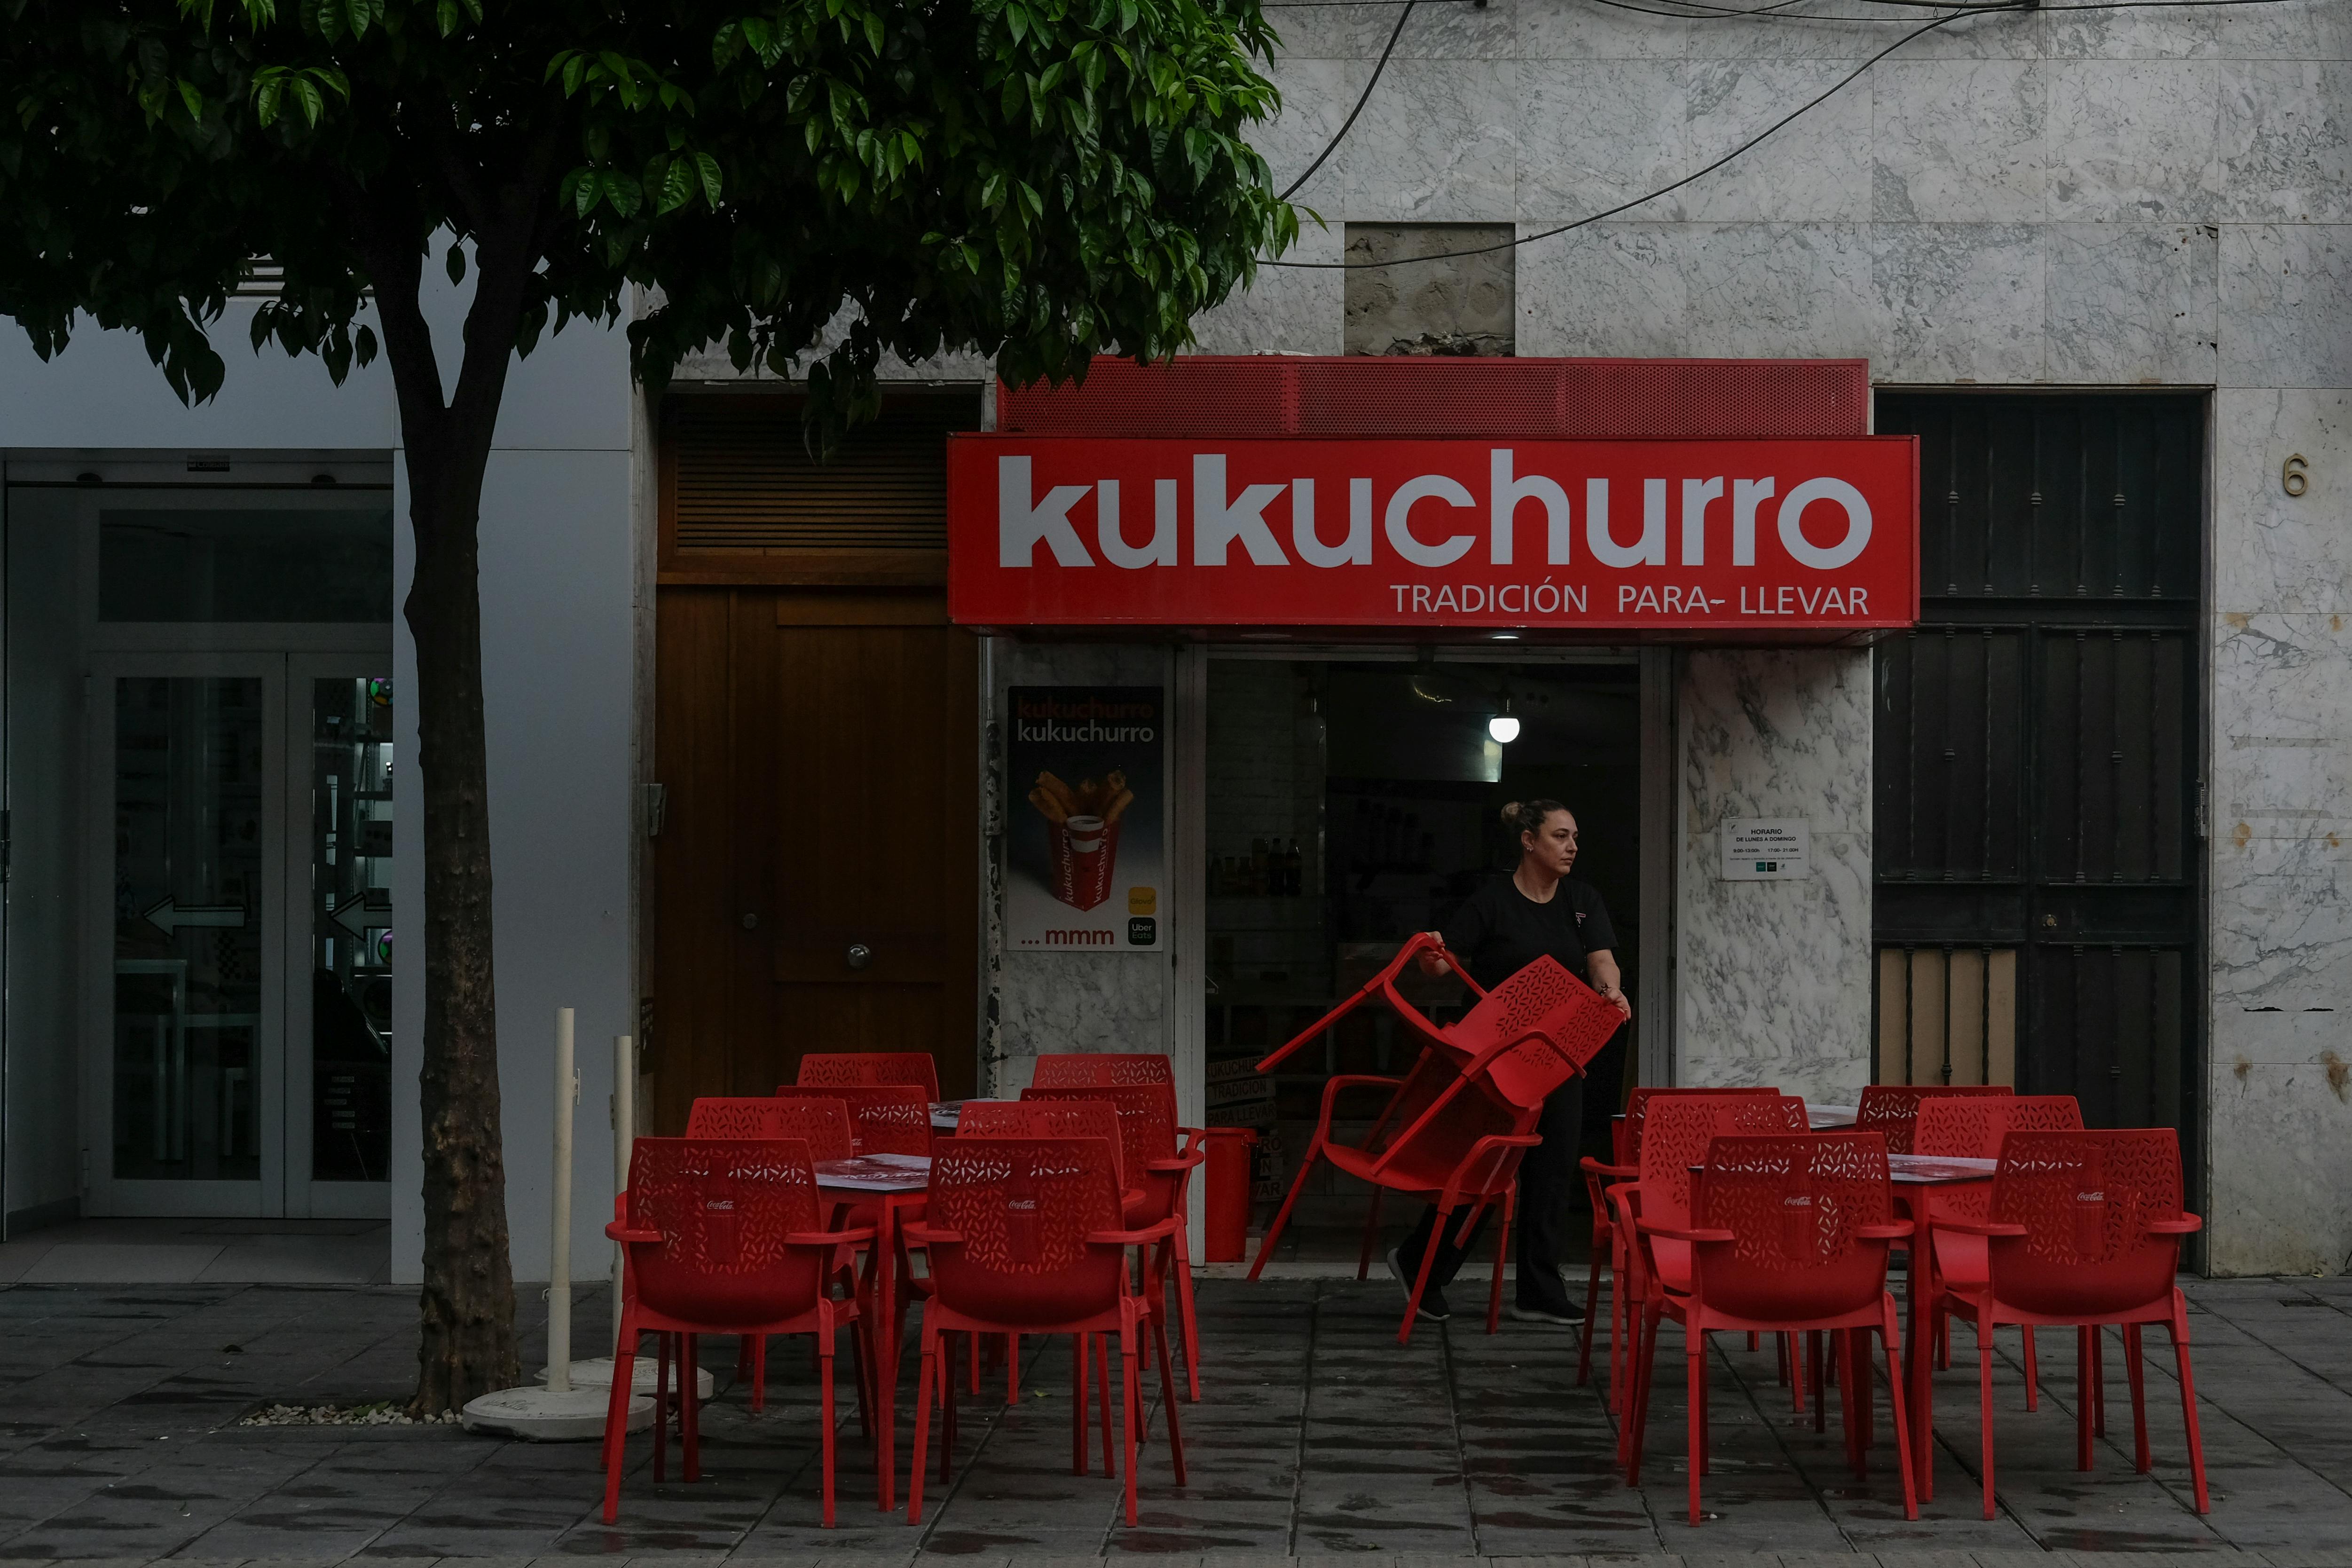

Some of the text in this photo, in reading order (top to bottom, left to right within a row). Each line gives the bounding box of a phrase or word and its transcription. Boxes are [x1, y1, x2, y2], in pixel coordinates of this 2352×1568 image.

[2283, 453, 2308, 496] 6
[999, 449, 1872, 569] kukuchurro
[1390, 576, 1586, 613] TRADICIÓN
[1741, 587, 1869, 615] LLEVAR
[1017, 718, 1155, 742] kukuchurro
[1062, 828, 1074, 903] kukuchurro
[1207, 1110, 1235, 1127] PARA
